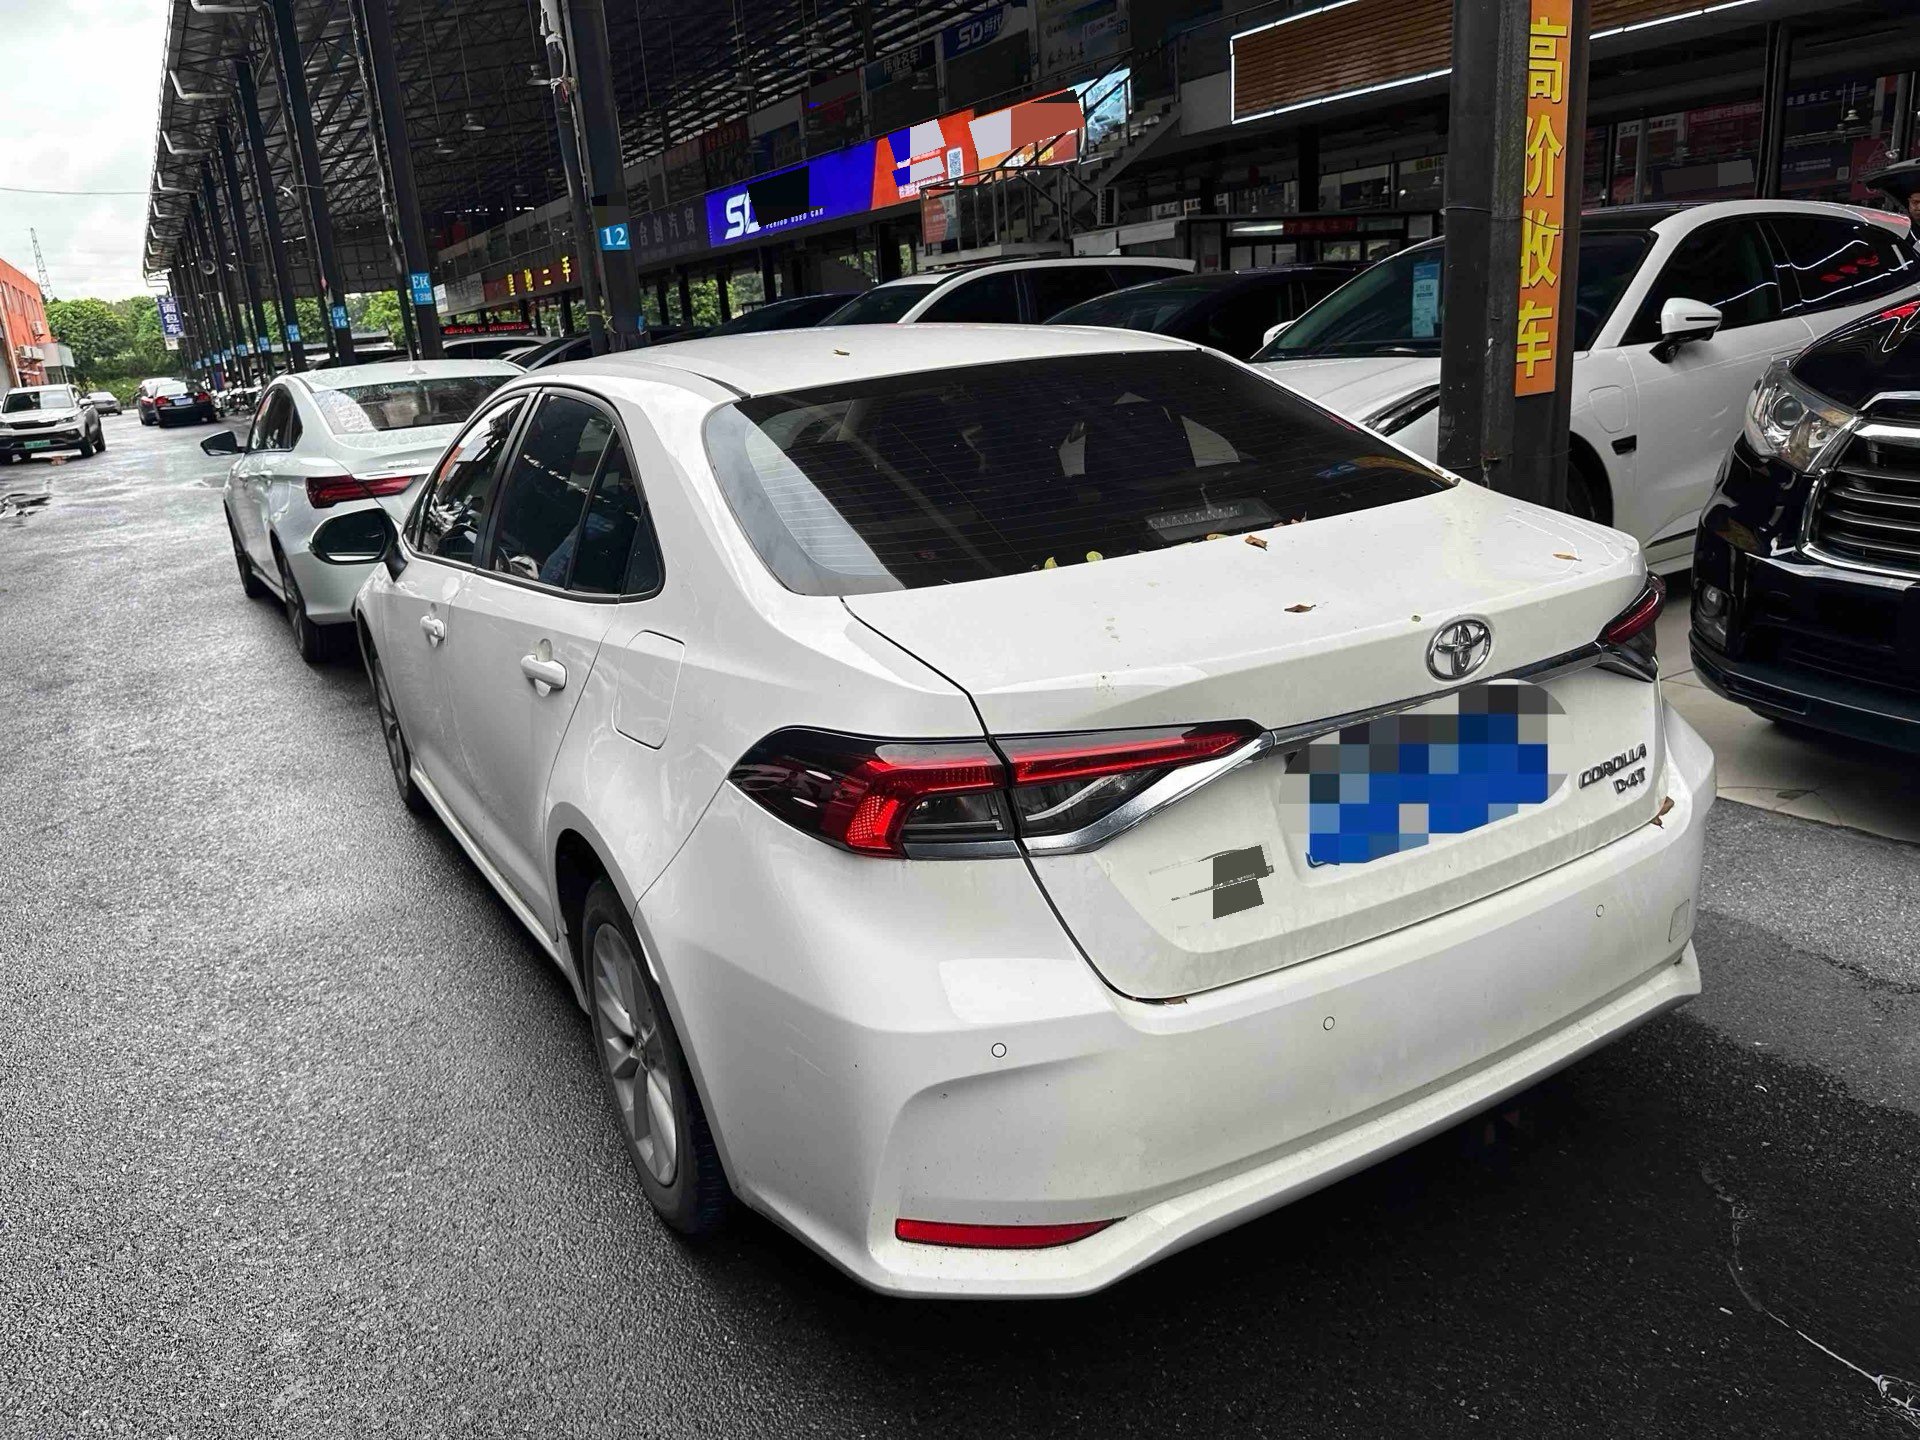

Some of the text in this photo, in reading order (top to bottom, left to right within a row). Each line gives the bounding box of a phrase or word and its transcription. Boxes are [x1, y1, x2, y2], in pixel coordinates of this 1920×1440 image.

[1515, 16, 1567, 378] 高价收车
[810, 207, 824, 218] CAR
[602, 227, 627, 246] 12
[335, 318, 347, 327] 16
[1578, 743, 1647, 790] COROLLA
